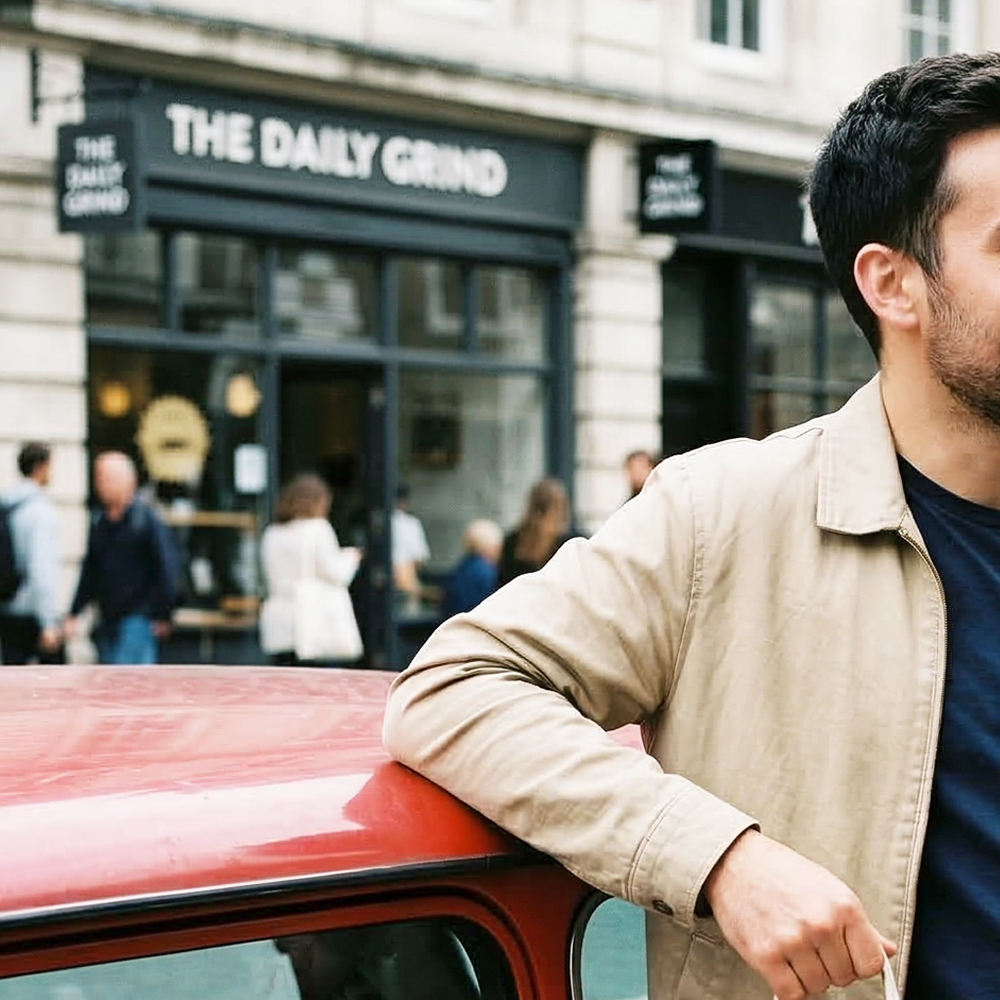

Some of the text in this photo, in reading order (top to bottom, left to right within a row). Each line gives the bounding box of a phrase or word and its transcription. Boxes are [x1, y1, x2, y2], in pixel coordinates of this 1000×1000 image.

[74, 134, 117, 162] THE
[166, 103, 508, 197] THE DAILY GRIND
